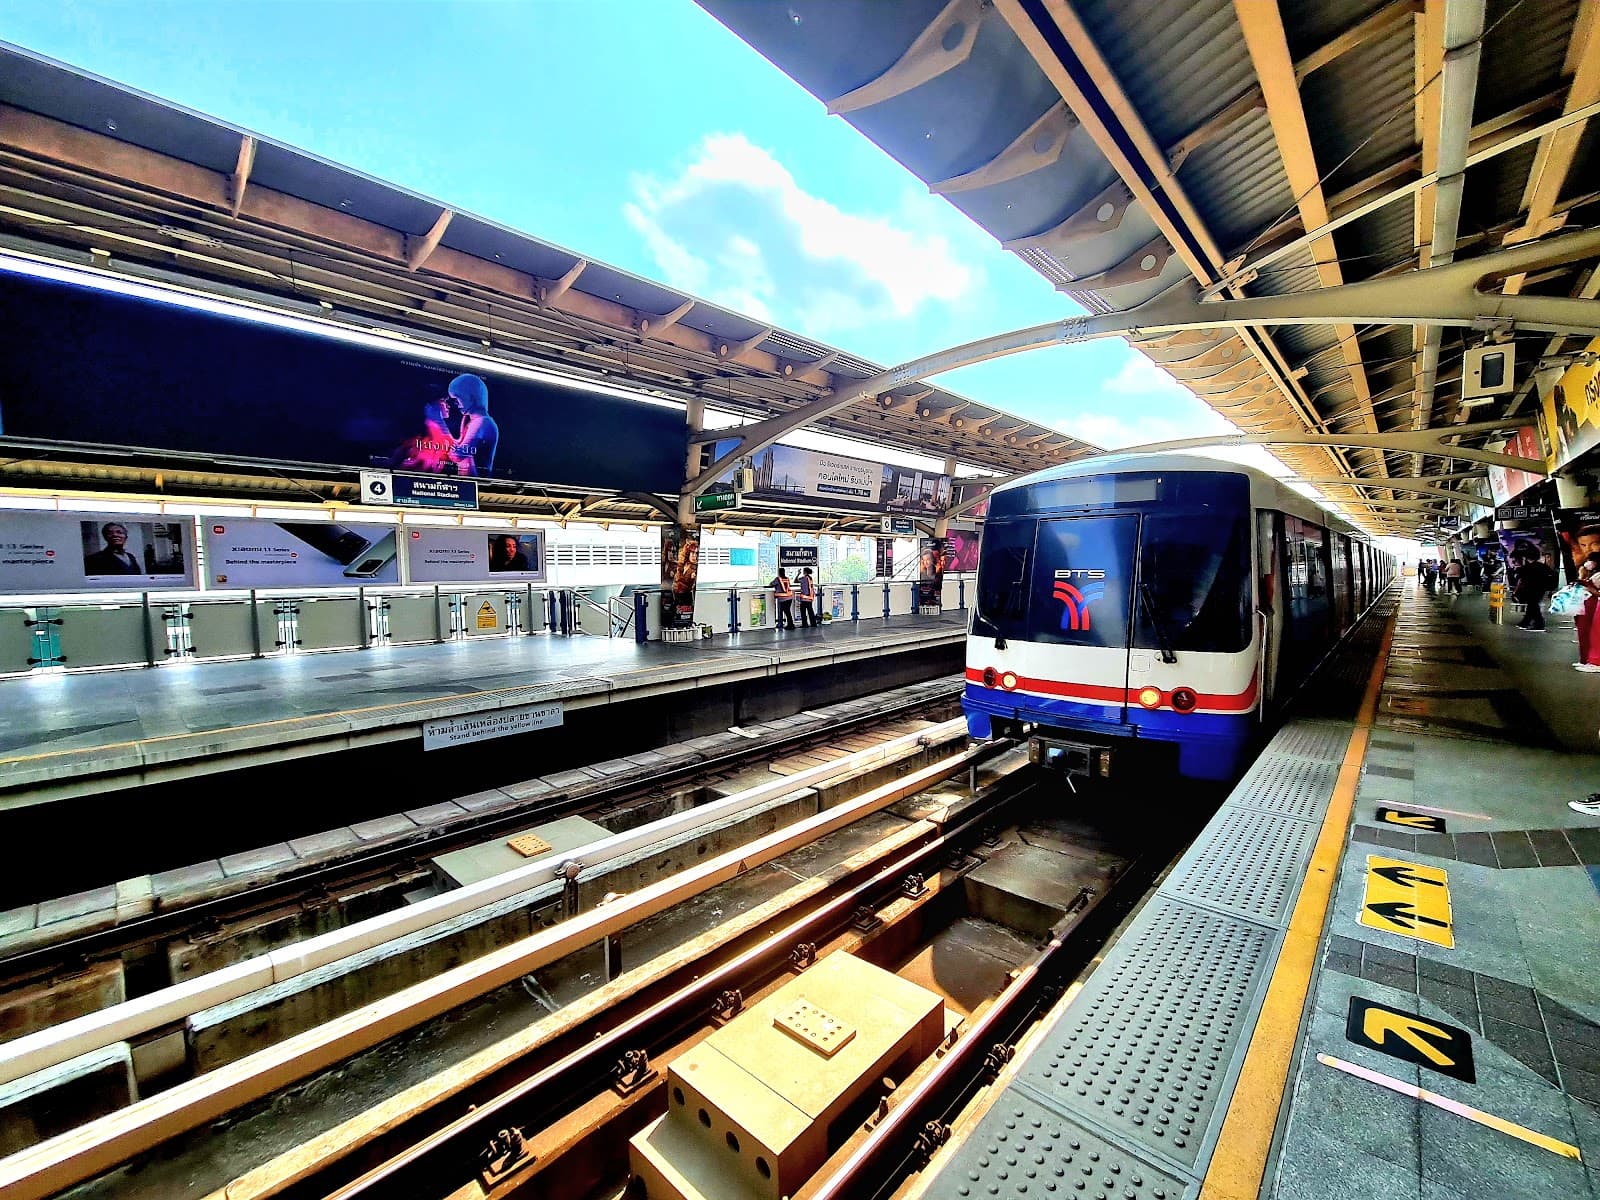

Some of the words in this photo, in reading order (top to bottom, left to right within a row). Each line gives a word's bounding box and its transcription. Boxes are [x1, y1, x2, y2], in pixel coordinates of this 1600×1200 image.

[374, 483, 383, 493] 4
[413, 481, 459, 492] สนามกีฬาฯ
[411, 489, 436, 497] National
[437, 491, 460, 499] Stadium
[1054, 569, 1105, 579] BTS
[449, 731, 470, 740] Stand
[472, 727, 496, 736] behind
[510, 721, 531, 730] yellow
